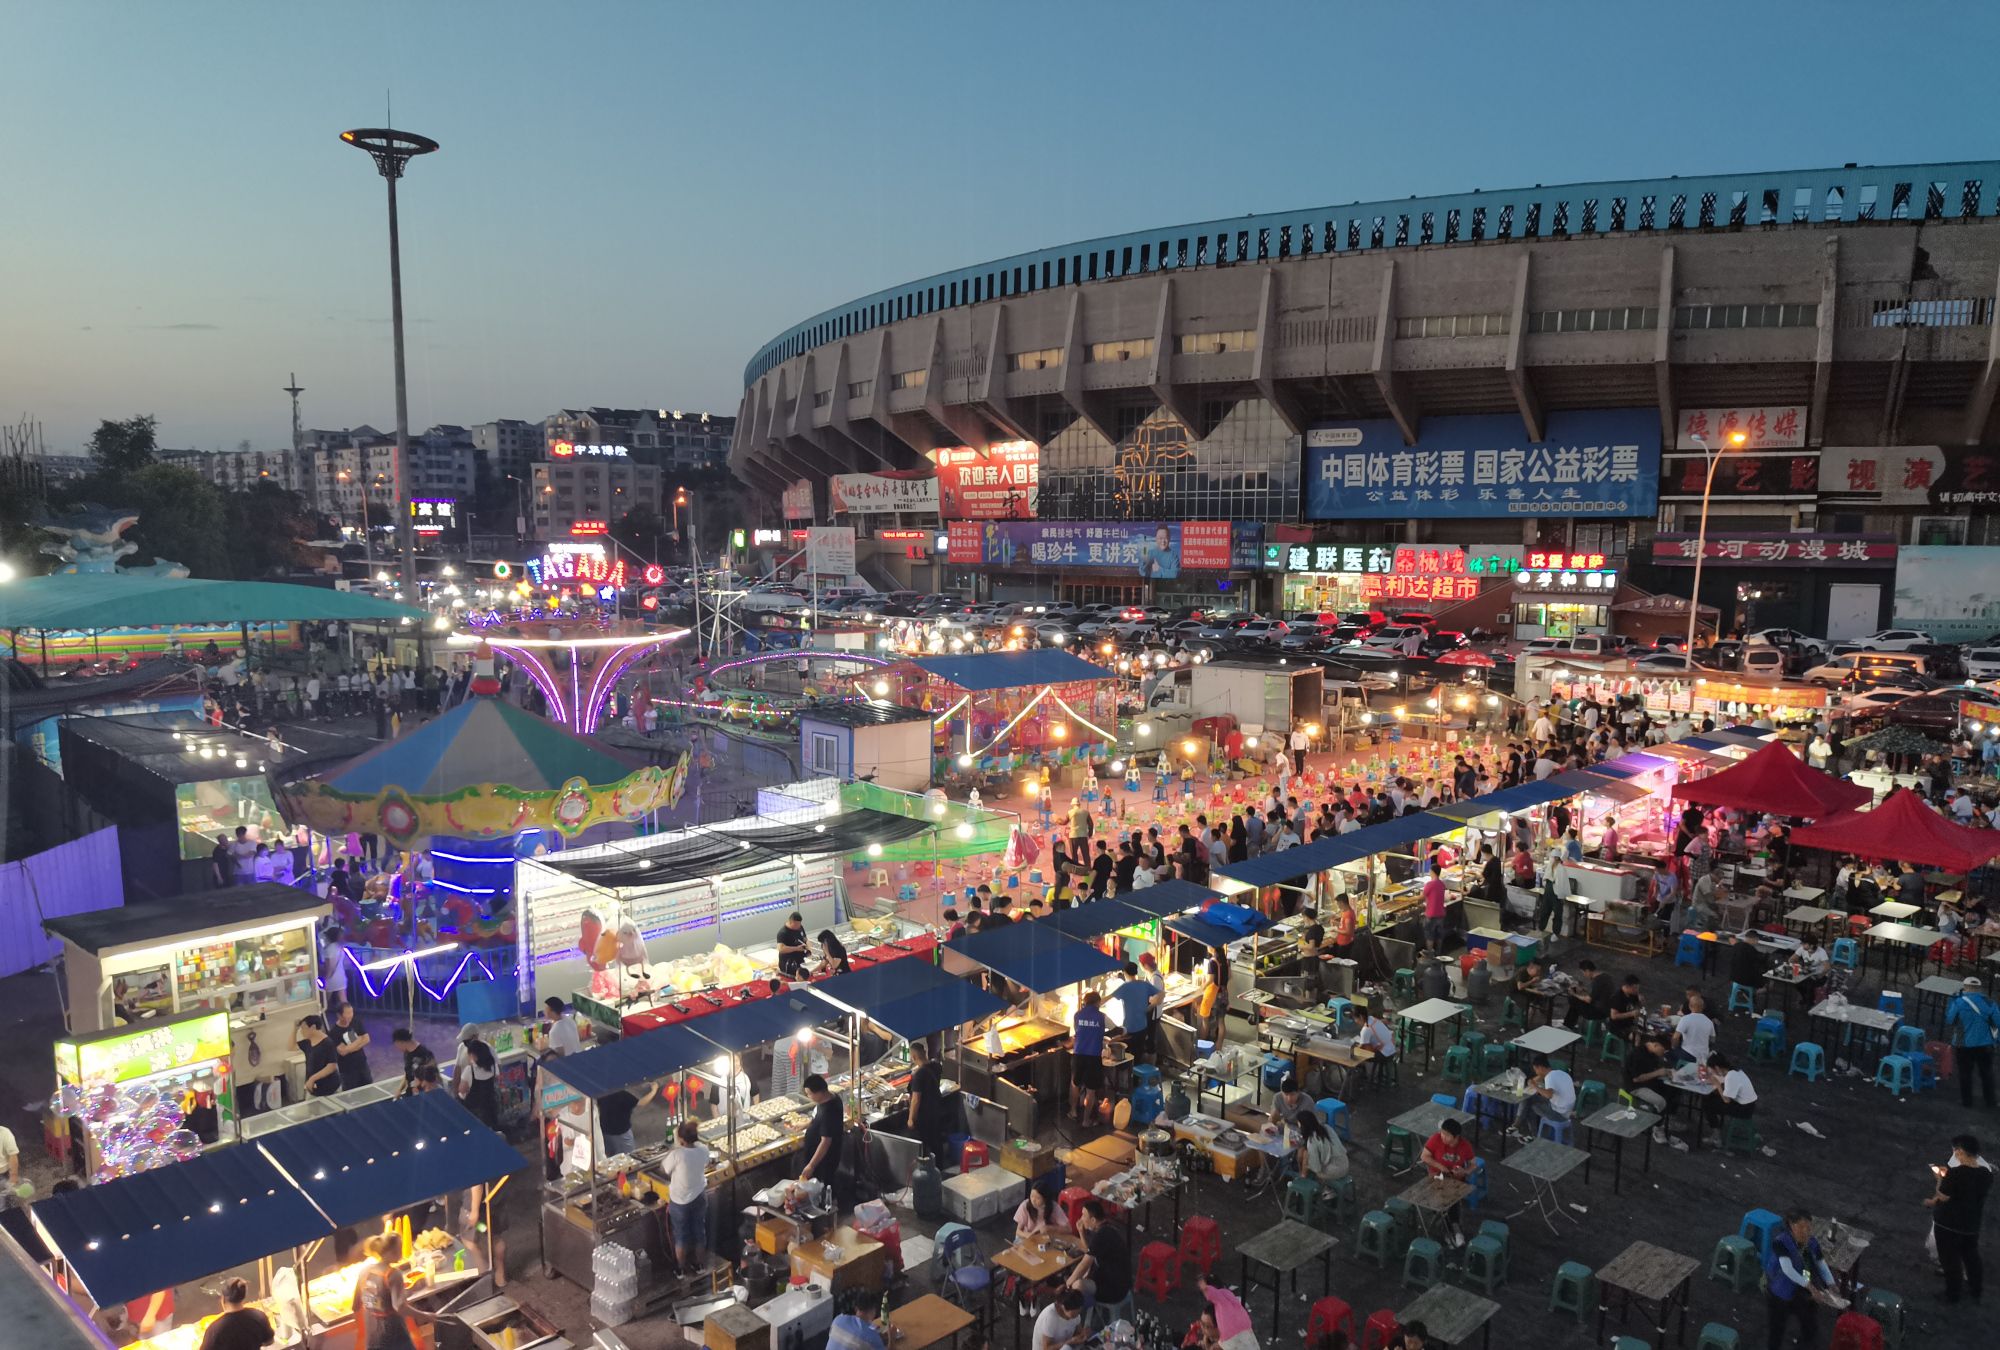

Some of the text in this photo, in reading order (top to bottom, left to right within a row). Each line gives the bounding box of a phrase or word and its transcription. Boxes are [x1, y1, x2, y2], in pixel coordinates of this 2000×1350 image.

[958, 463, 1039, 486] 欢迎亲人回家
[1320, 445, 1639, 488] 中国体育彩票 国家公益彩票
[1365, 487, 1582, 502] 公益体彩 乐善人生
[1086, 527, 1129, 539] 好酒牛栏山
[1031, 542, 1139, 564] 喝珍牛 更讲究
[1288, 546, 1392, 572] 建联医药
[1530, 553, 1564, 568] 汉堡
[1679, 539, 1871, 561] 银河动漫城
[526, 551, 625, 588] TAGADA
[1360, 574, 1478, 600] 惠利达超市
